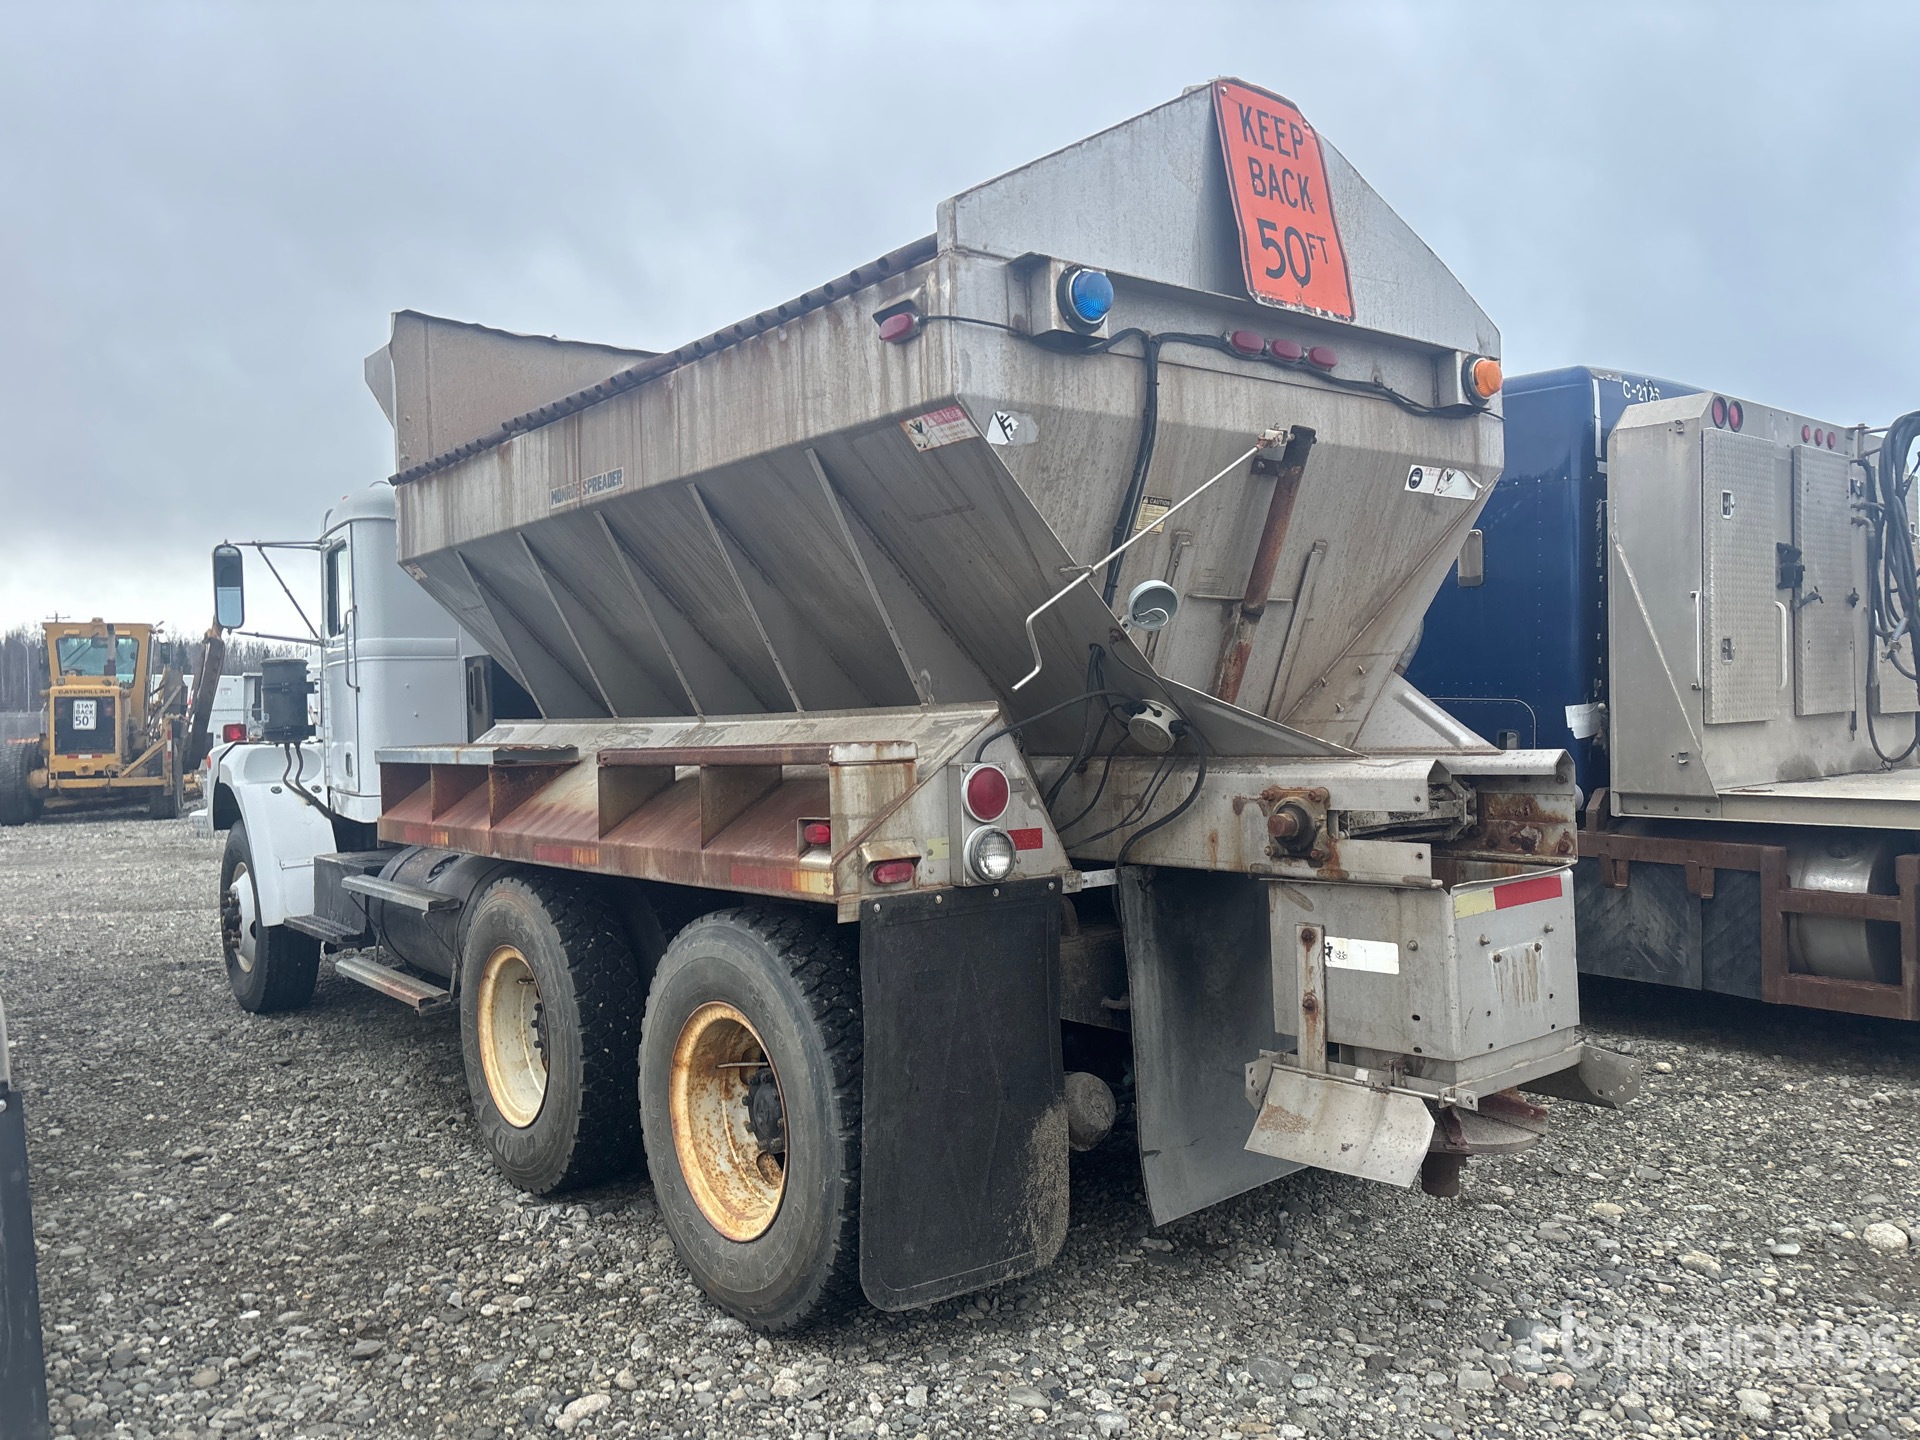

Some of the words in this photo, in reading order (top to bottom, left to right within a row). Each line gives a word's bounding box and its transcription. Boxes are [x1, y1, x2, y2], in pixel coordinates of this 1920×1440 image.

[1238, 103, 1304, 160] KEEP
[1248, 157, 1316, 214] BACK
[582, 468, 623, 496] SPREADER
[1149, 498, 1170, 506] CAUTION
